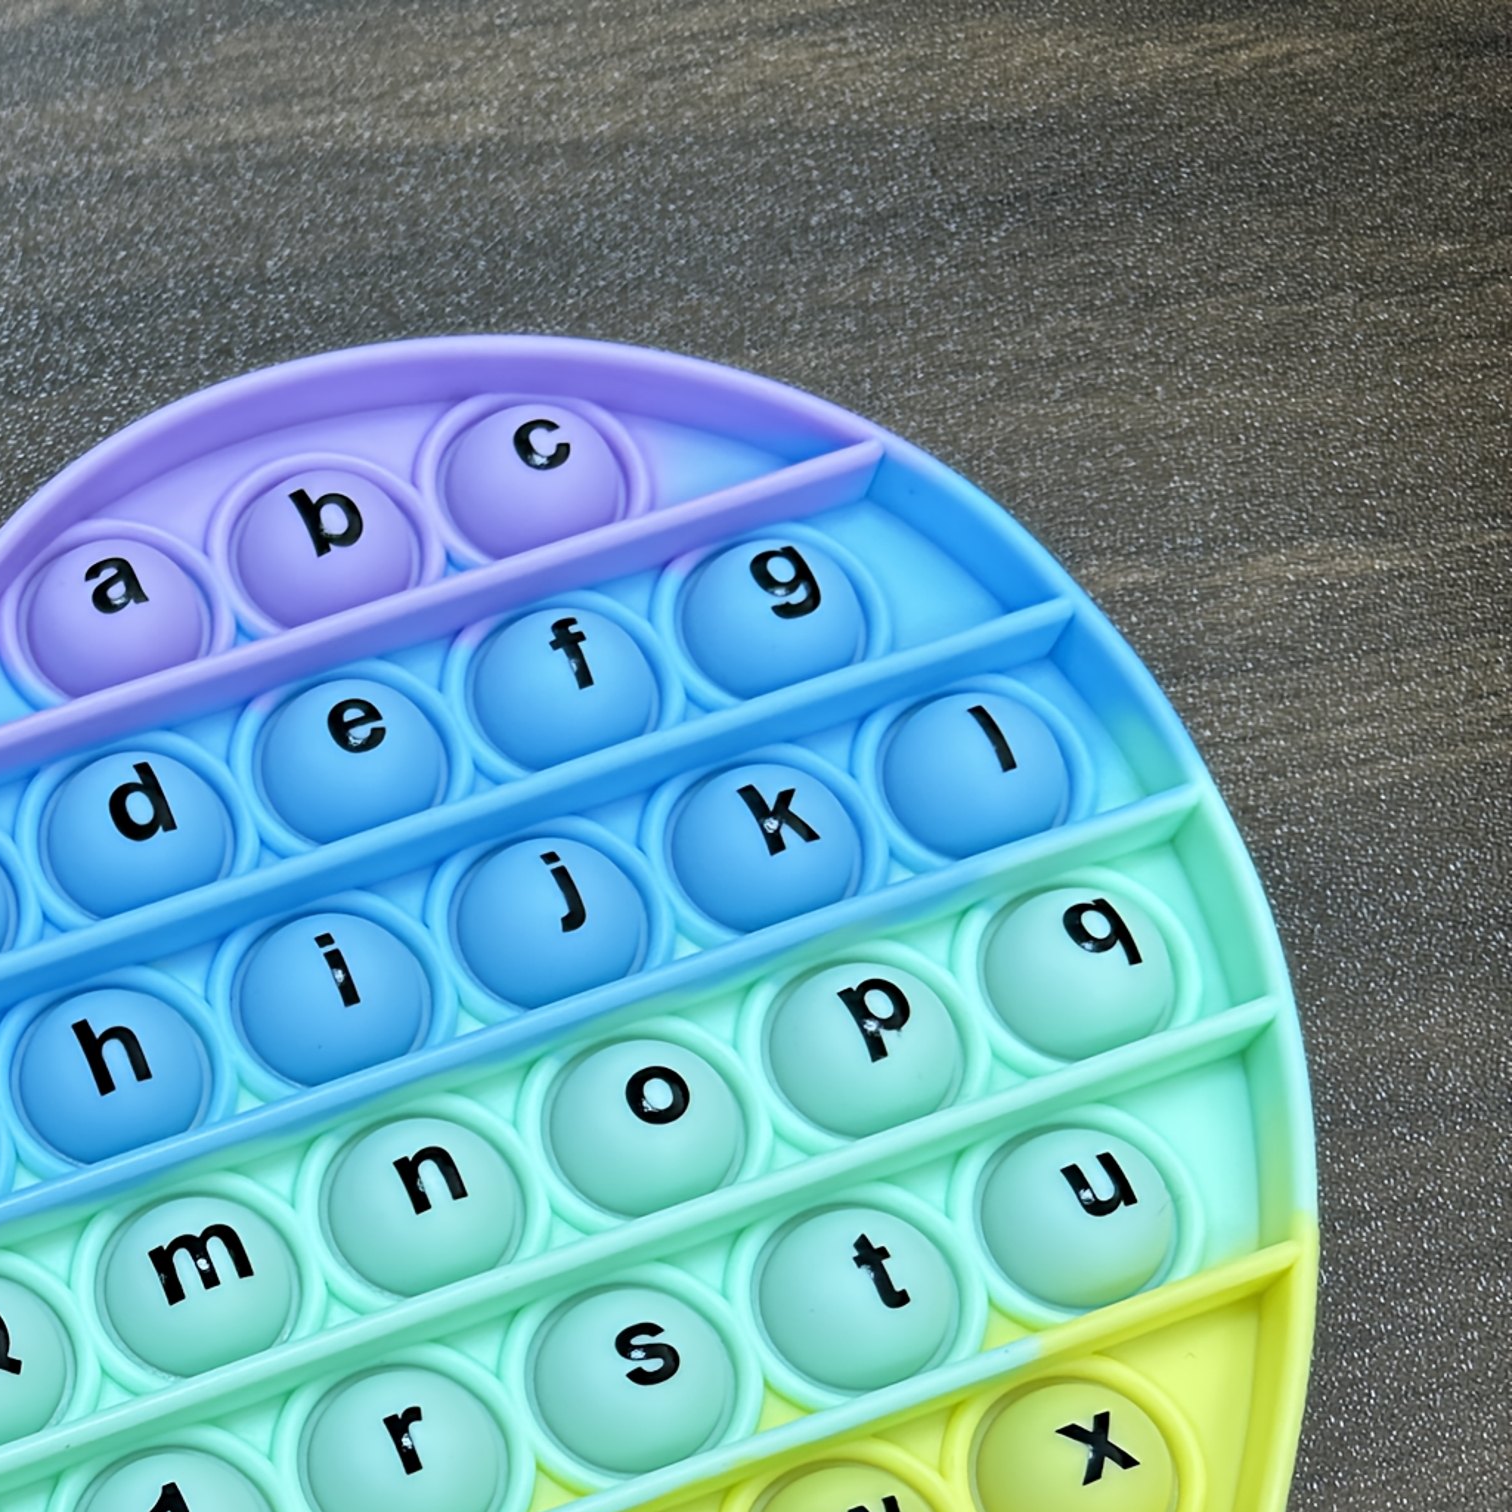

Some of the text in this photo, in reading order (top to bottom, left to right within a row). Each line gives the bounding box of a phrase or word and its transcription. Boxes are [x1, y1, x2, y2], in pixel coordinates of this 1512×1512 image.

[85, 419, 571, 614] a b c
[108, 761, 177, 842] d
[327, 698, 386, 753] e
[549, 617, 594, 689] f
[750, 545, 821, 619] g
[71, 1019, 153, 1096] h
[314, 932, 361, 1007] i
[540, 851, 587, 932] j
[737, 784, 820, 856] k
[147, 1223, 254, 1306] m
[392, 1146, 468, 1215] n
[625, 1065, 690, 1125] o
[836, 978, 911, 1063] p
[1062, 898, 1143, 966] q
[382, 1406, 423, 1475] r
[614, 1322, 680, 1386] s
[853, 1233, 911, 1309] t
[1060, 1152, 1138, 1217] u
[1055, 1411, 1141, 1486] x
